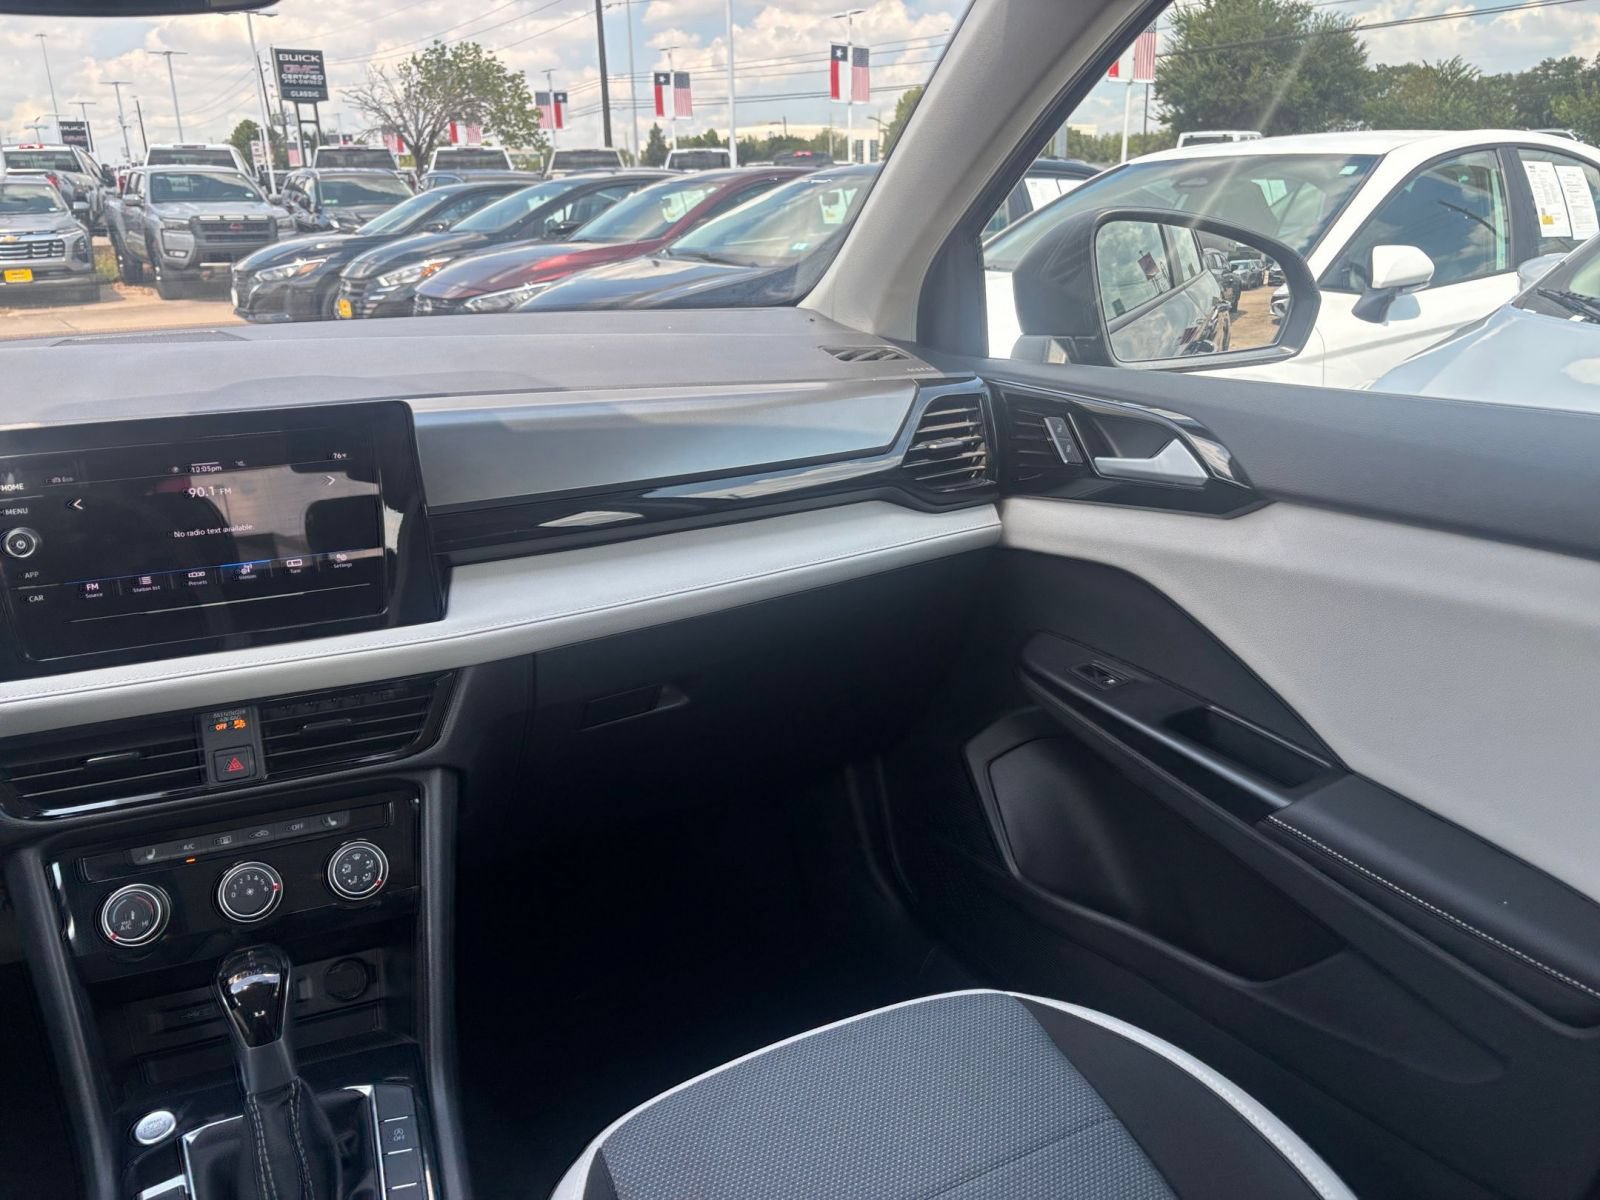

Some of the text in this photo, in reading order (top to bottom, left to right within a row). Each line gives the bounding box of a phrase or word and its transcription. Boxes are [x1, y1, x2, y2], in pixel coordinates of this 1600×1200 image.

[279, 53, 320, 62] BUICK
[188, 486, 232, 498] 90.1 FM
[5, 507, 29, 516] MENU
[187, 529, 206, 537] radio
[24, 571, 39, 579] APP
[86, 583, 99, 591] FM
[28, 595, 44, 603] CAR
[215, 722, 228, 731] OFF
[292, 823, 304, 831] OFF
